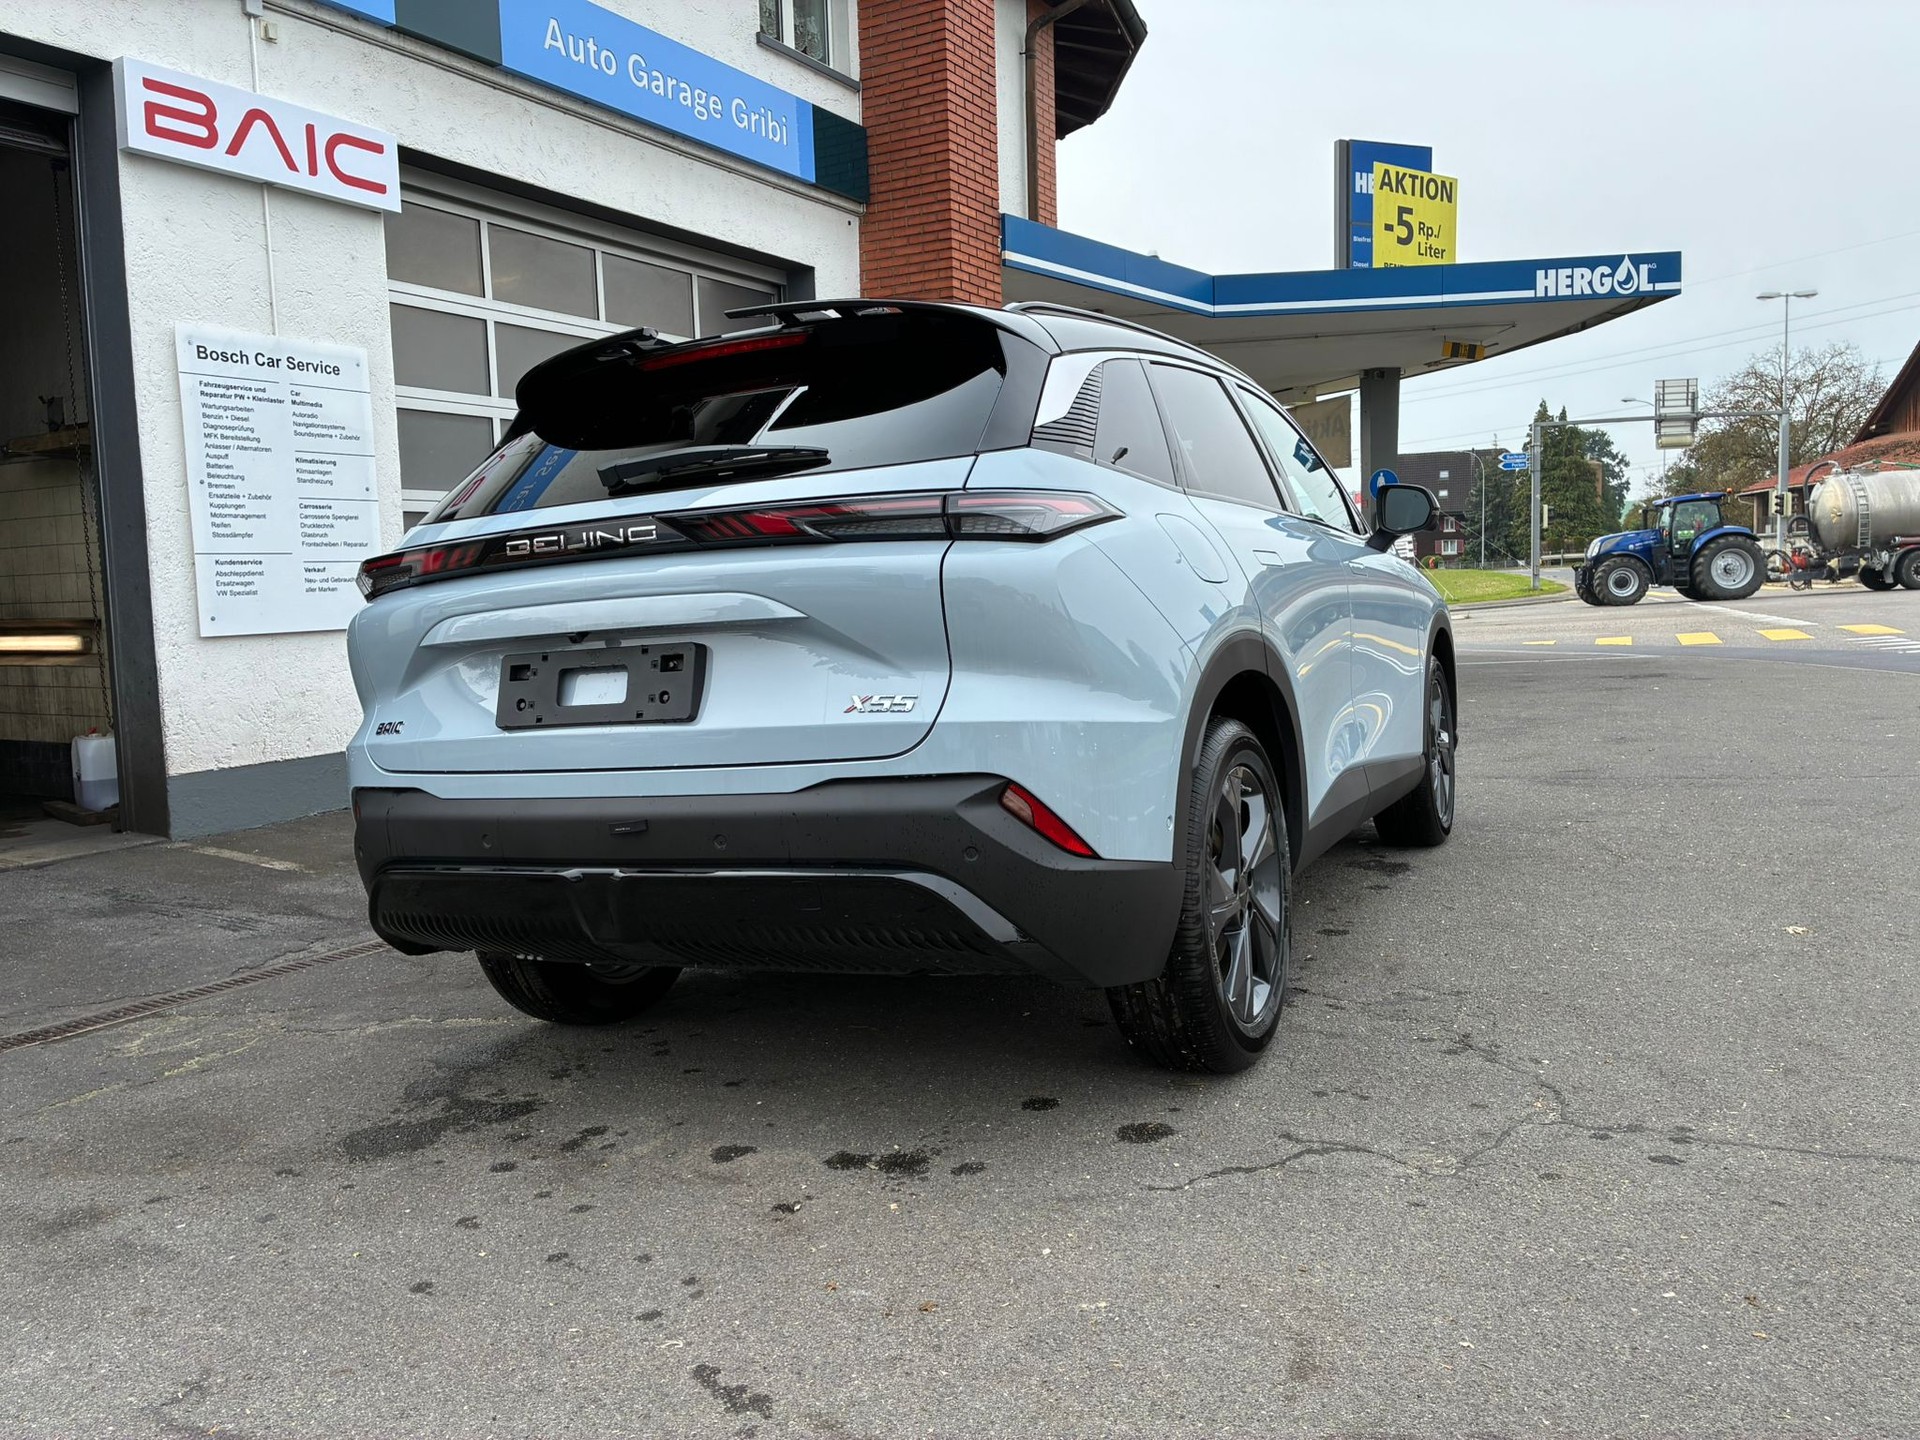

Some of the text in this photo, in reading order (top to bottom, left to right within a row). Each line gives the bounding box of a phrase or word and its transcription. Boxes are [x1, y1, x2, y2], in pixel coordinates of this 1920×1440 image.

[543, 17, 788, 146] Auto Garage Gribi
[142, 76, 387, 194] BAIC
[1379, 168, 1453, 203] AKTION
[1384, 205, 1441, 246] -5 Rp./
[1418, 241, 1446, 259] Liter
[196, 345, 340, 376] Bosch Car Service
[199, 380, 252, 392] Fahrzeugservice
[200, 390, 232, 399] Reparatur
[201, 402, 254, 412] Wartungsarbeiten
[291, 399, 323, 408] Multimedia
[202, 412, 223, 420] Benzin
[292, 411, 318, 419] Autoradio
[203, 422, 254, 433] Diagnoseprüfung
[293, 421, 345, 431] Navigationssysteme
[203, 432, 261, 443] MFK Bereitstellung
[294, 430, 333, 439] Soundsysteme
[236, 444, 272, 453] Alternatoren
[205, 452, 229, 460] Auspuff
[206, 462, 234, 470] Batterien
[295, 457, 337, 466] Klimatisierung
[207, 472, 245, 481] Beleuchtung
[296, 468, 332, 476] Klimaanlagen
[297, 477, 333, 486] Standheizung
[209, 502, 246, 510] Kupplungen
[210, 512, 266, 520] Motormanagement
[212, 531, 254, 539] Stossdämpfer
[506, 524, 657, 556] BEIJING
[844, 694, 918, 713] X55
[376, 721, 404, 735] BAIC
